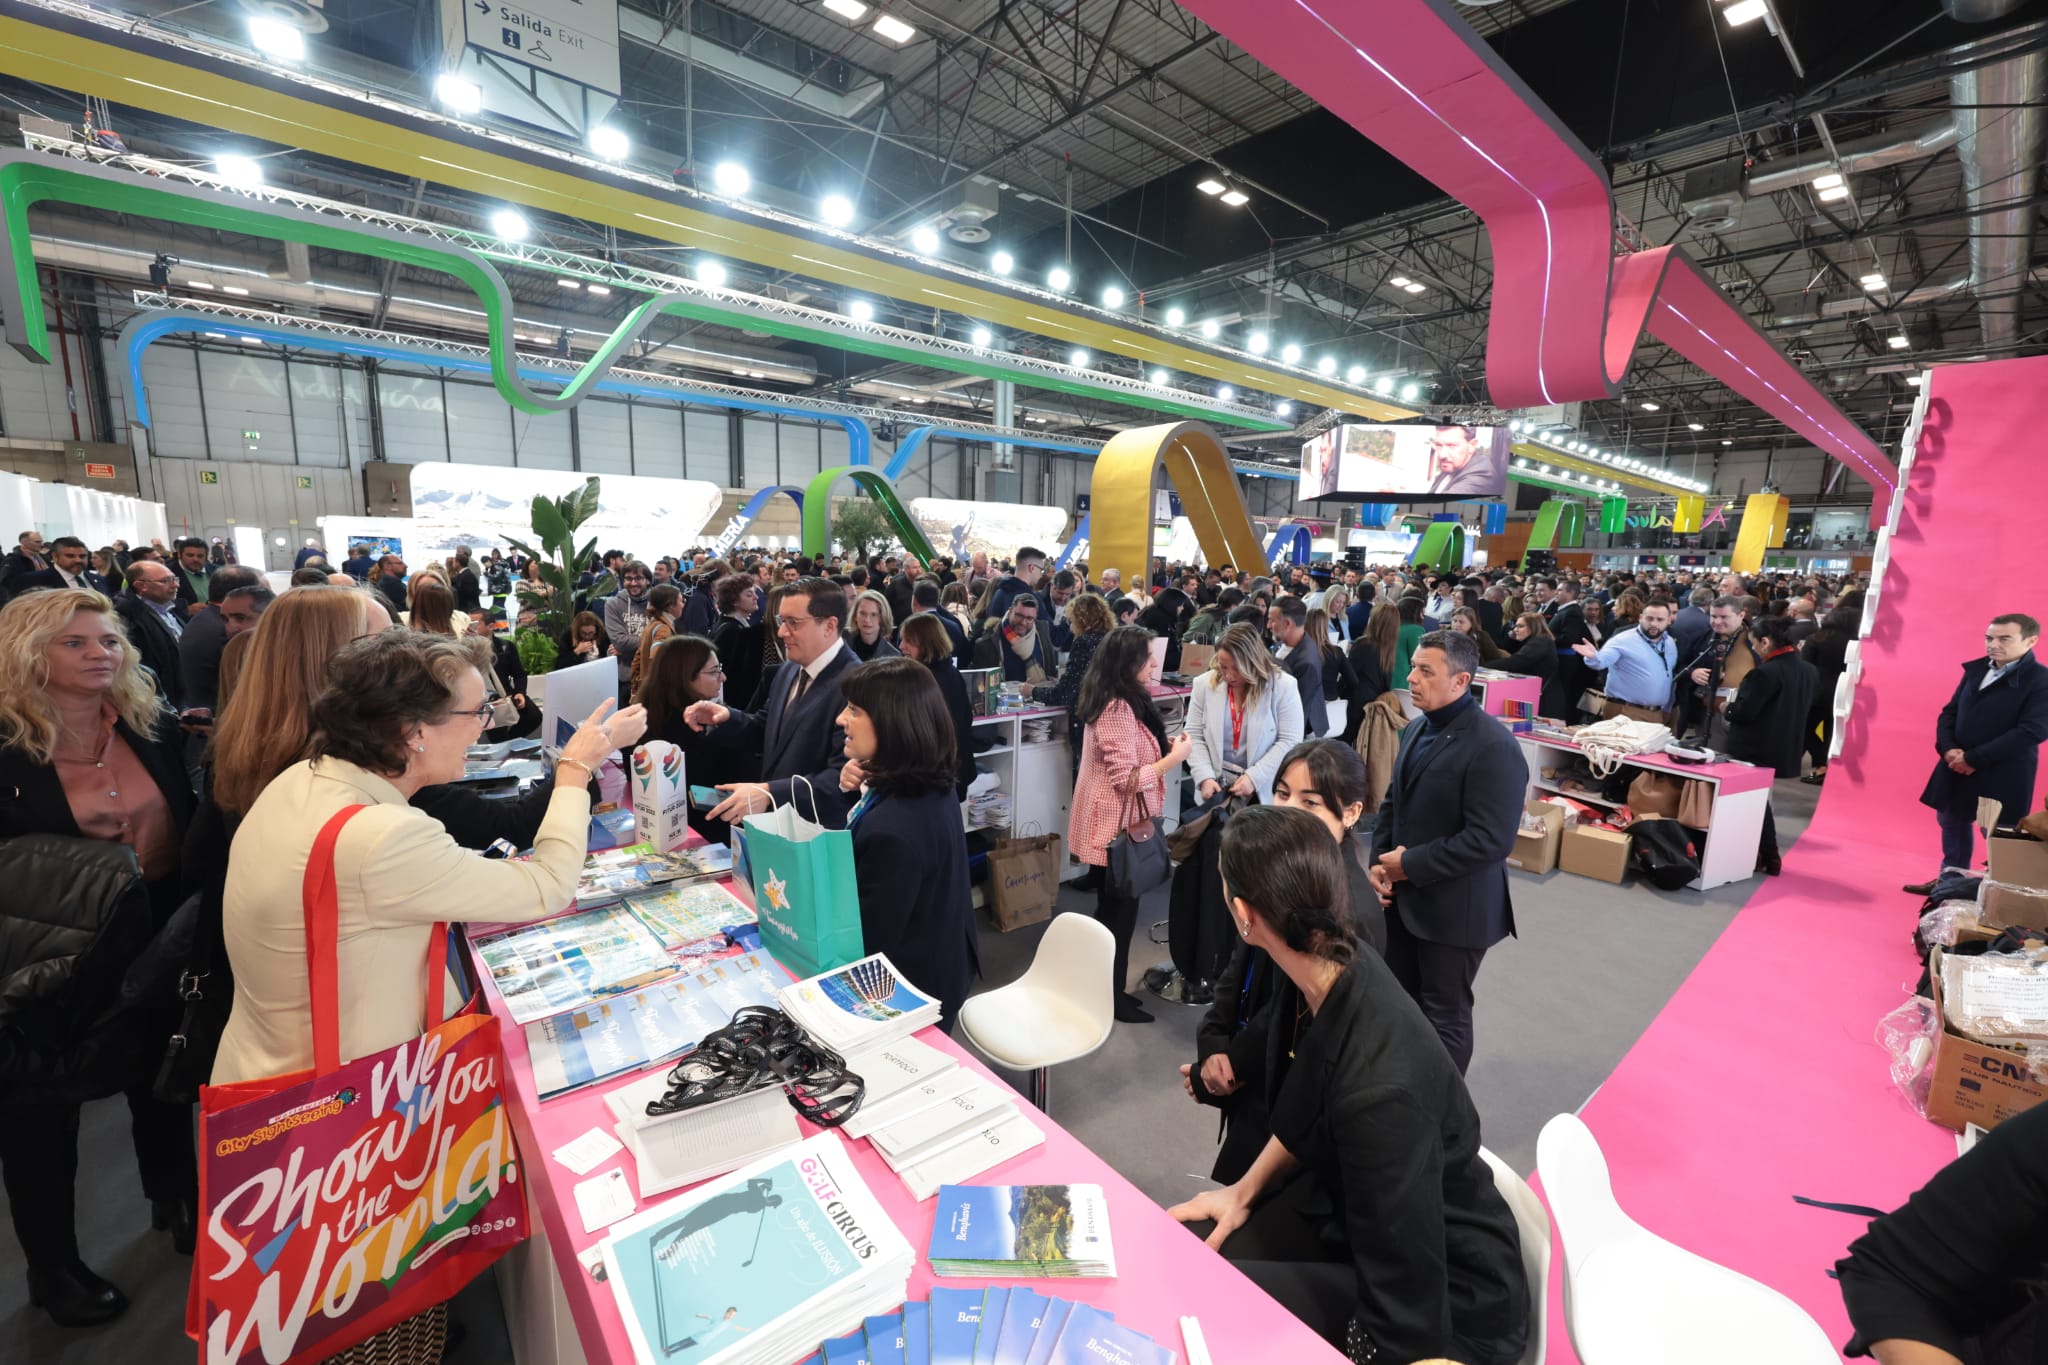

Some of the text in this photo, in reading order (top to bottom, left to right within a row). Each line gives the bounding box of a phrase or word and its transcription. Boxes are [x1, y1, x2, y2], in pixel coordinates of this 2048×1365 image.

[500, 7, 584, 49] Salida Exit
[371, 1033, 442, 1118] We
[880, 1051, 919, 1075] PORTFOLIO
[207, 1103, 418, 1281] Show
[336, 1184, 392, 1243] the
[800, 1158, 878, 1260] GOLF CIRCUS
